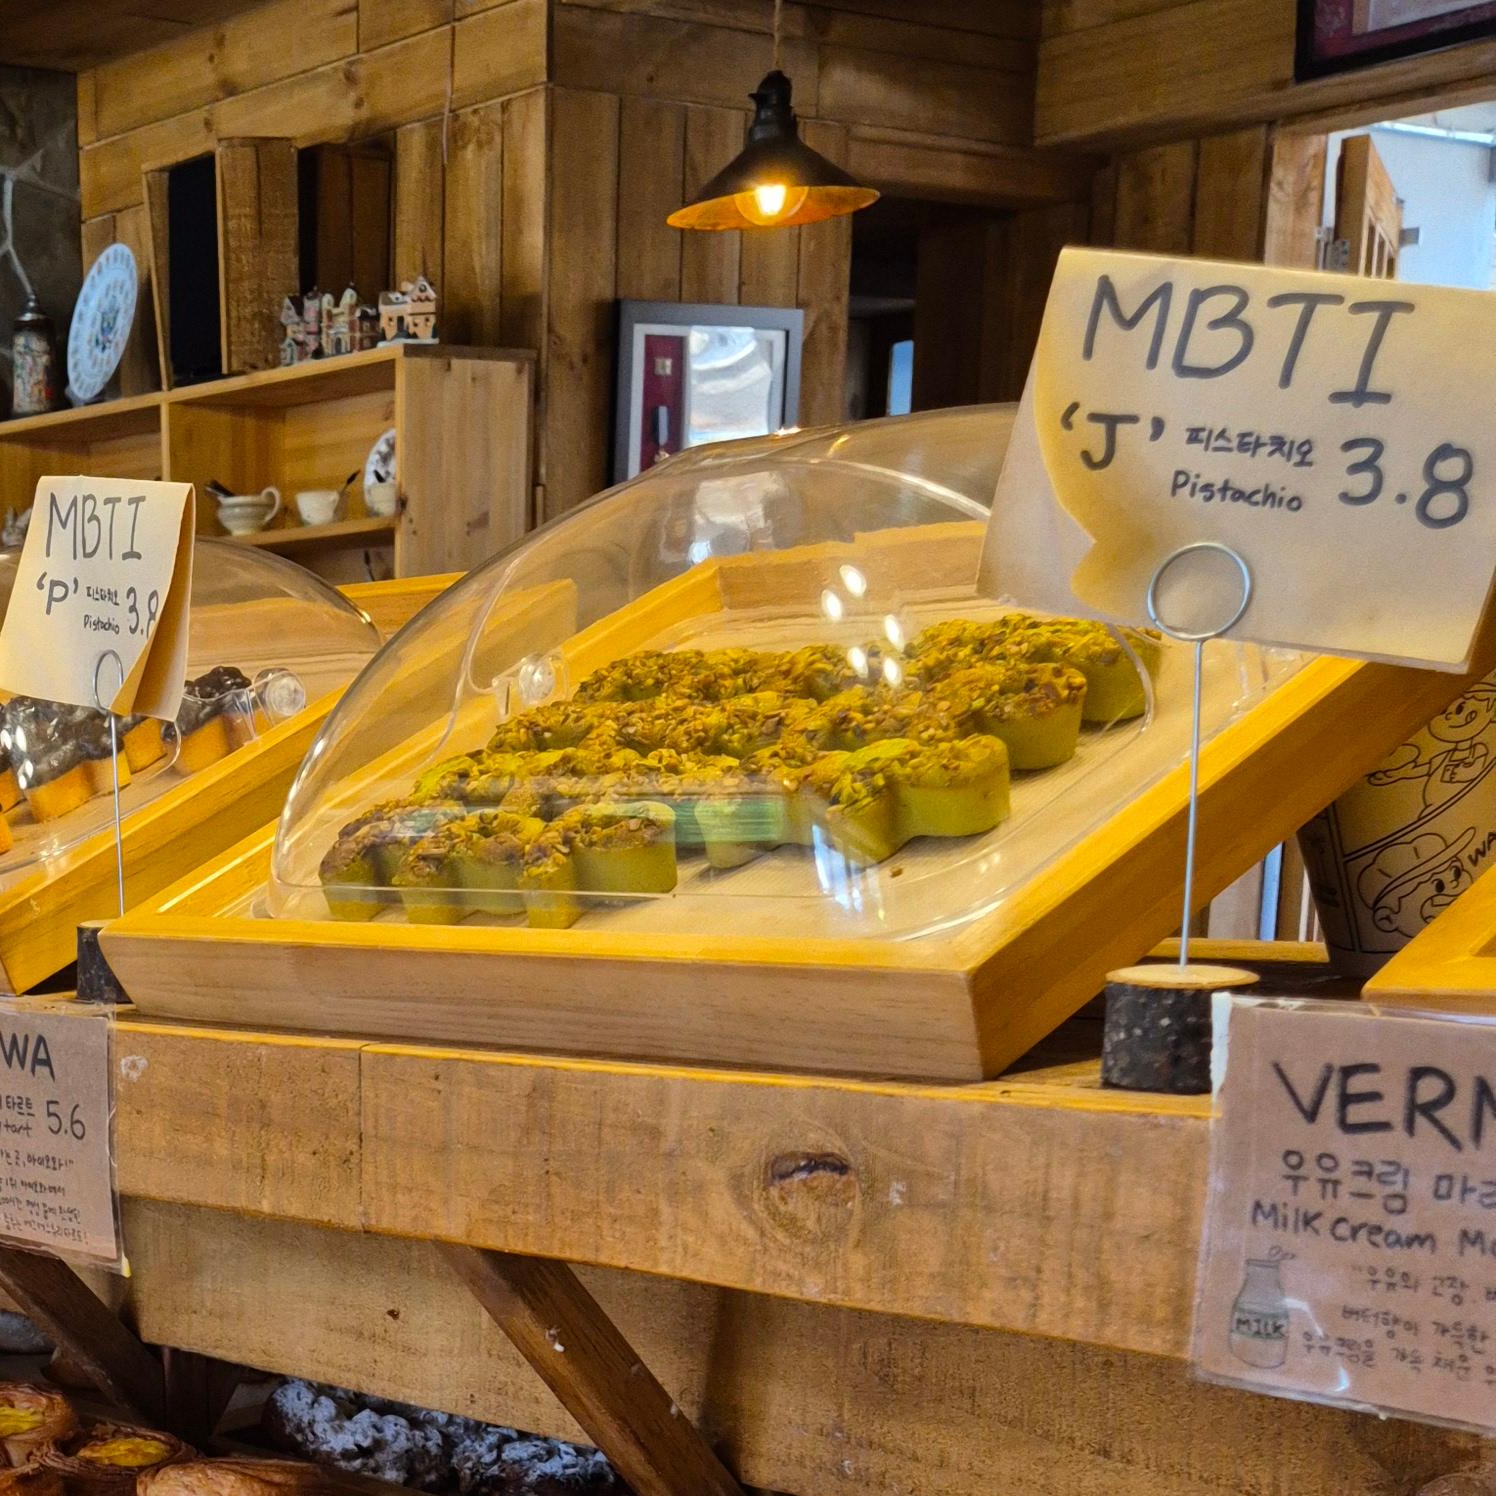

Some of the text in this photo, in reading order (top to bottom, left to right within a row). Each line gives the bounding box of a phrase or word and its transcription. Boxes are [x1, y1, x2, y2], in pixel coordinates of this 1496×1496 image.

[1082, 274, 1415, 408] MBTI
[1171, 469, 1303, 513] Pistachio
[1185, 425, 1315, 468] 피스타치오
[1339, 437, 1474, 529] 3.8
[45, 491, 146, 560] MBTI
[84, 613, 120, 635] Pistachio
[4, 1119, 33, 1138] tart
[5, 1094, 36, 1117] 타르트
[45, 1100, 87, 1141] 5.6
[1281, 1149, 1410, 1214] 우유크림
[1330, 1211, 1436, 1254] Cream
[1236, 1317, 1286, 1337] MILK
